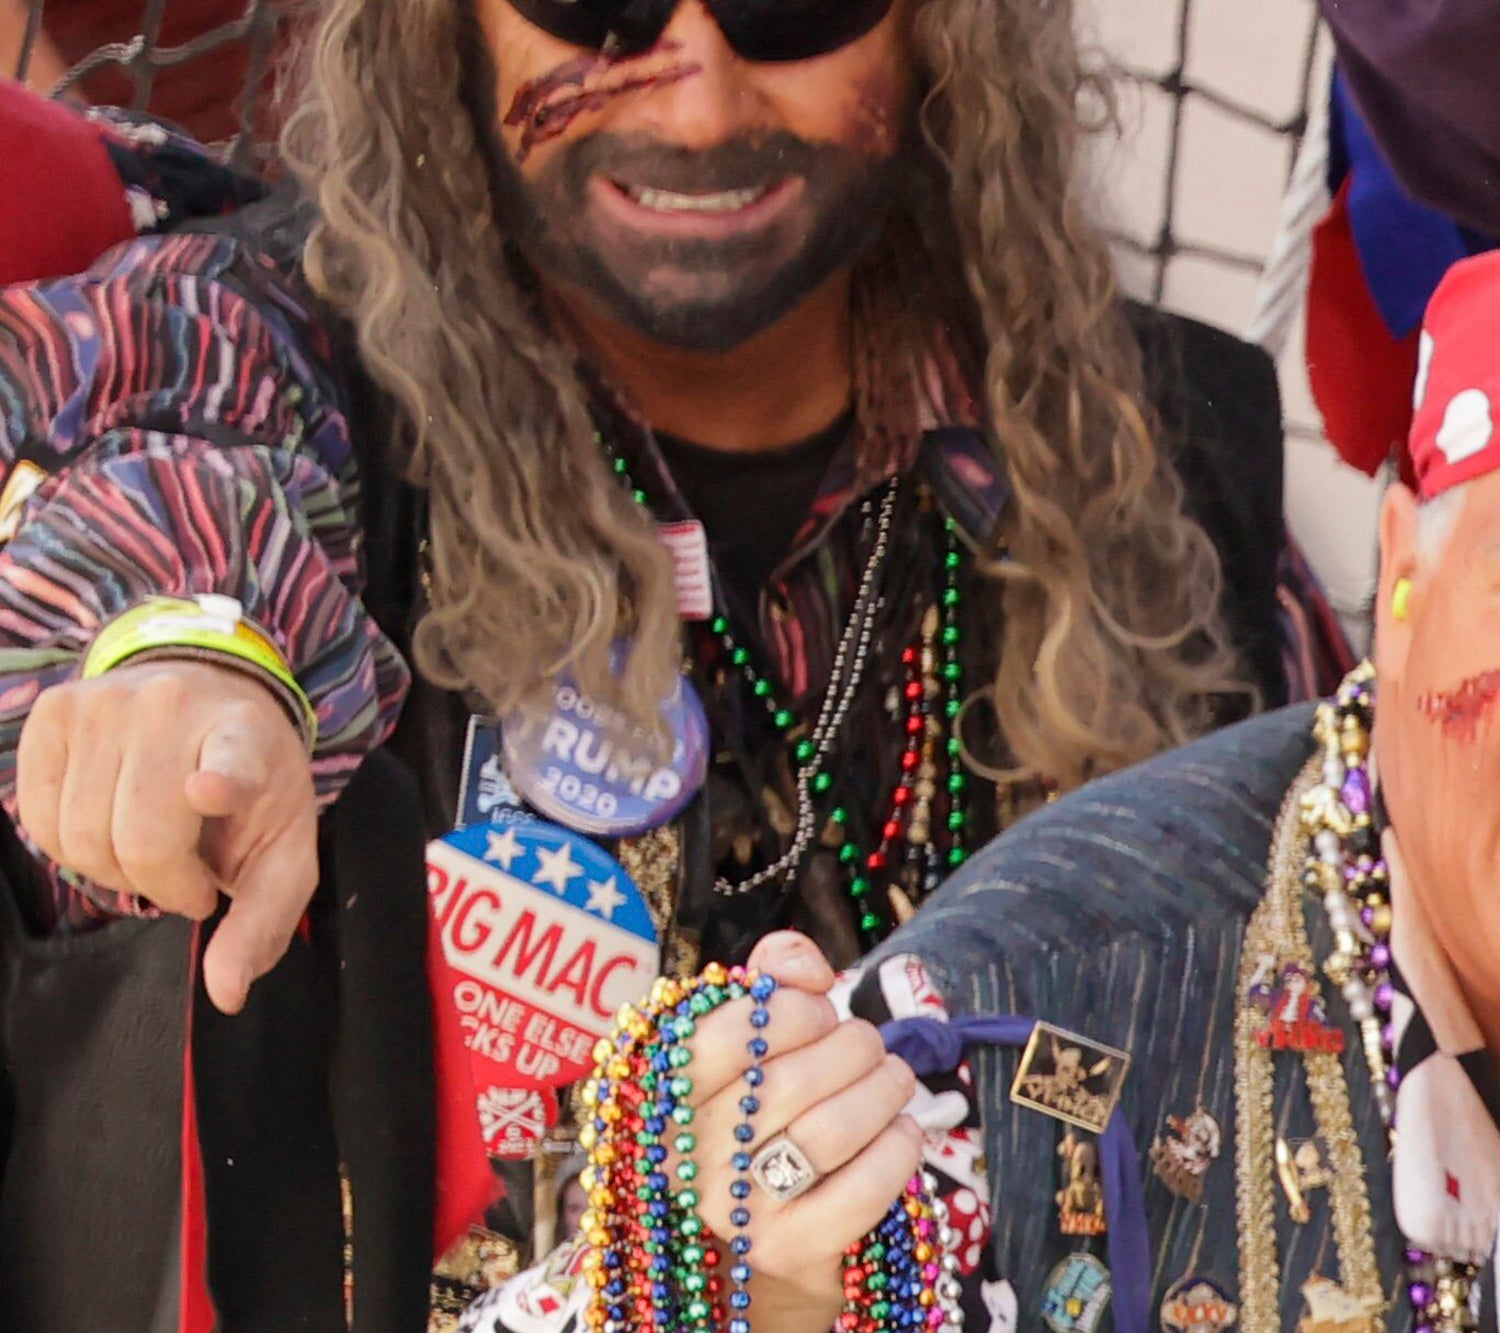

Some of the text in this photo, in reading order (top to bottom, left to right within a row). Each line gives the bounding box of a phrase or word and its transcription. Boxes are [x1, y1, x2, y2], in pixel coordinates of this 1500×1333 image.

[541, 714, 682, 801] RUMP
[541, 765, 619, 817] 2020
[493, 909, 638, 1019] MAC
[453, 980, 594, 1066] ONE ELSE
[515, 1045, 561, 1081] UP
